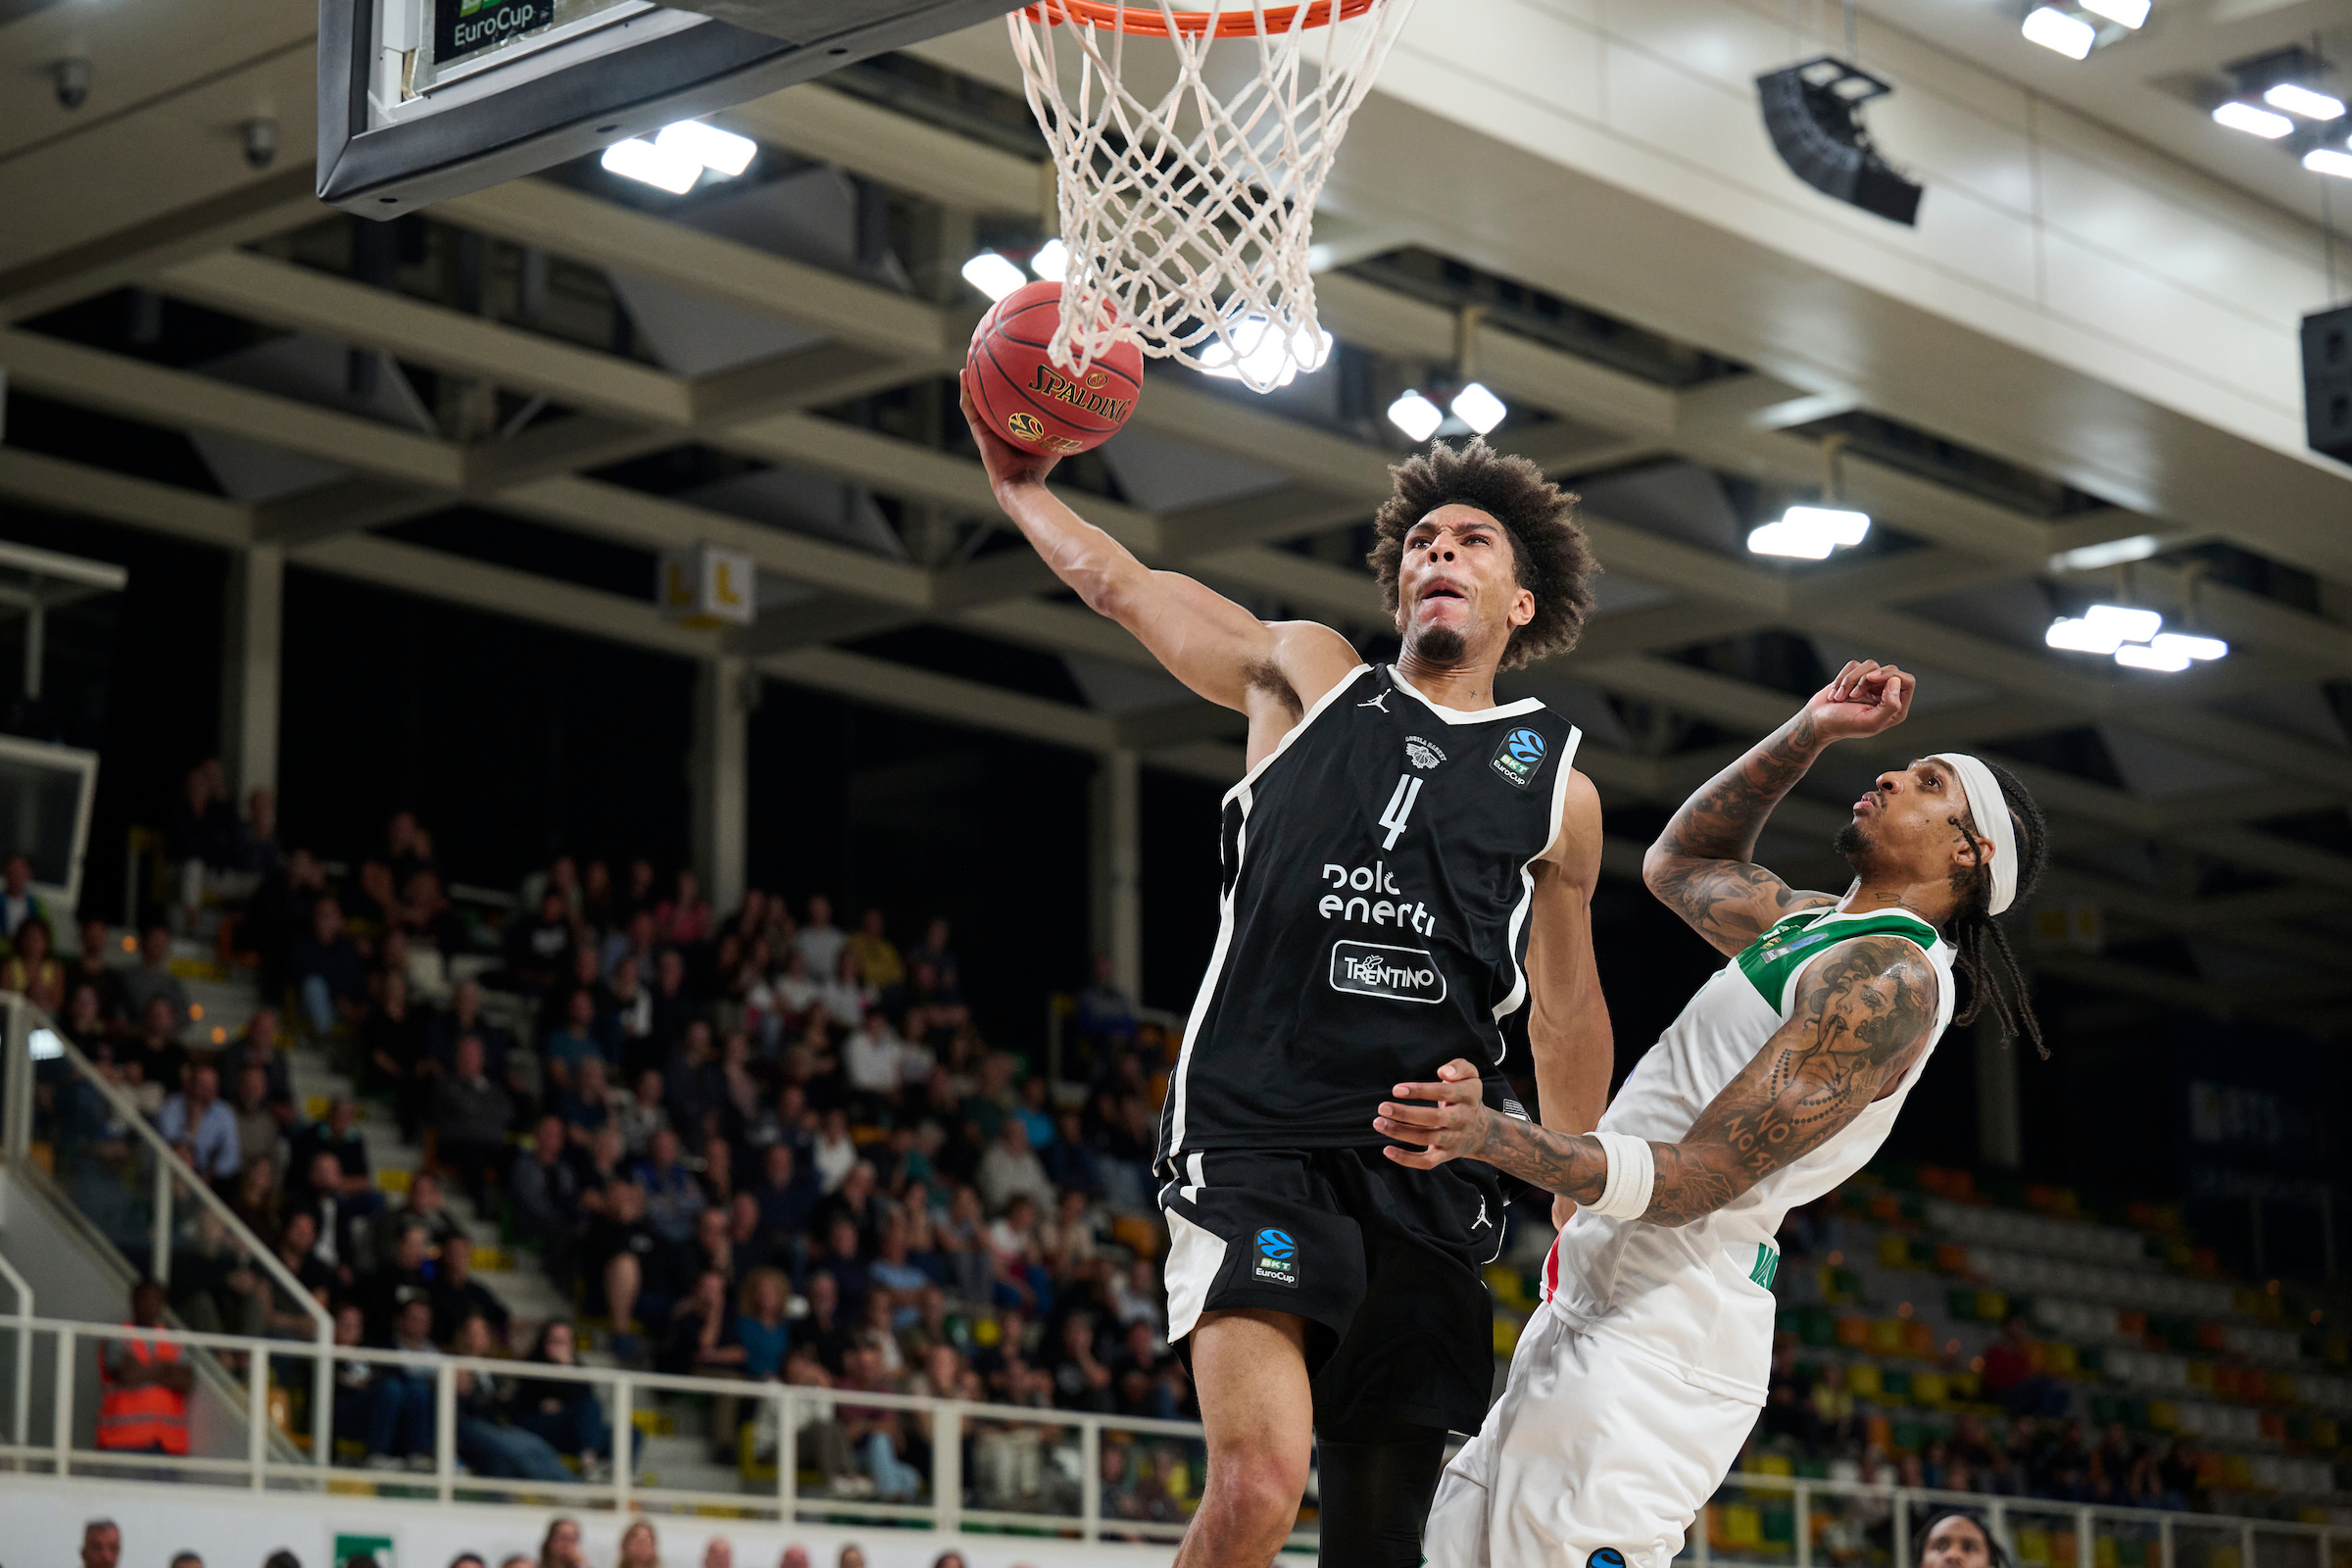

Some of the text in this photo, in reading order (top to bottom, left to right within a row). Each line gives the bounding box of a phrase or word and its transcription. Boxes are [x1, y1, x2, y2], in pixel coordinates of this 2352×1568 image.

[455, 4, 533, 47] EuroCup
[1028, 364, 1132, 424] SPALDING
[715, 560, 742, 606] L
[1493, 759, 1526, 785] EuroCup
[1500, 754, 1529, 773] BKT
[1378, 773, 1423, 852] 4
[1344, 956, 1435, 990] TRENTINO
[1754, 1106, 1790, 1144] NO
[1255, 1267, 1295, 1283] EuroCup
[1261, 1258, 1291, 1270] BKT
